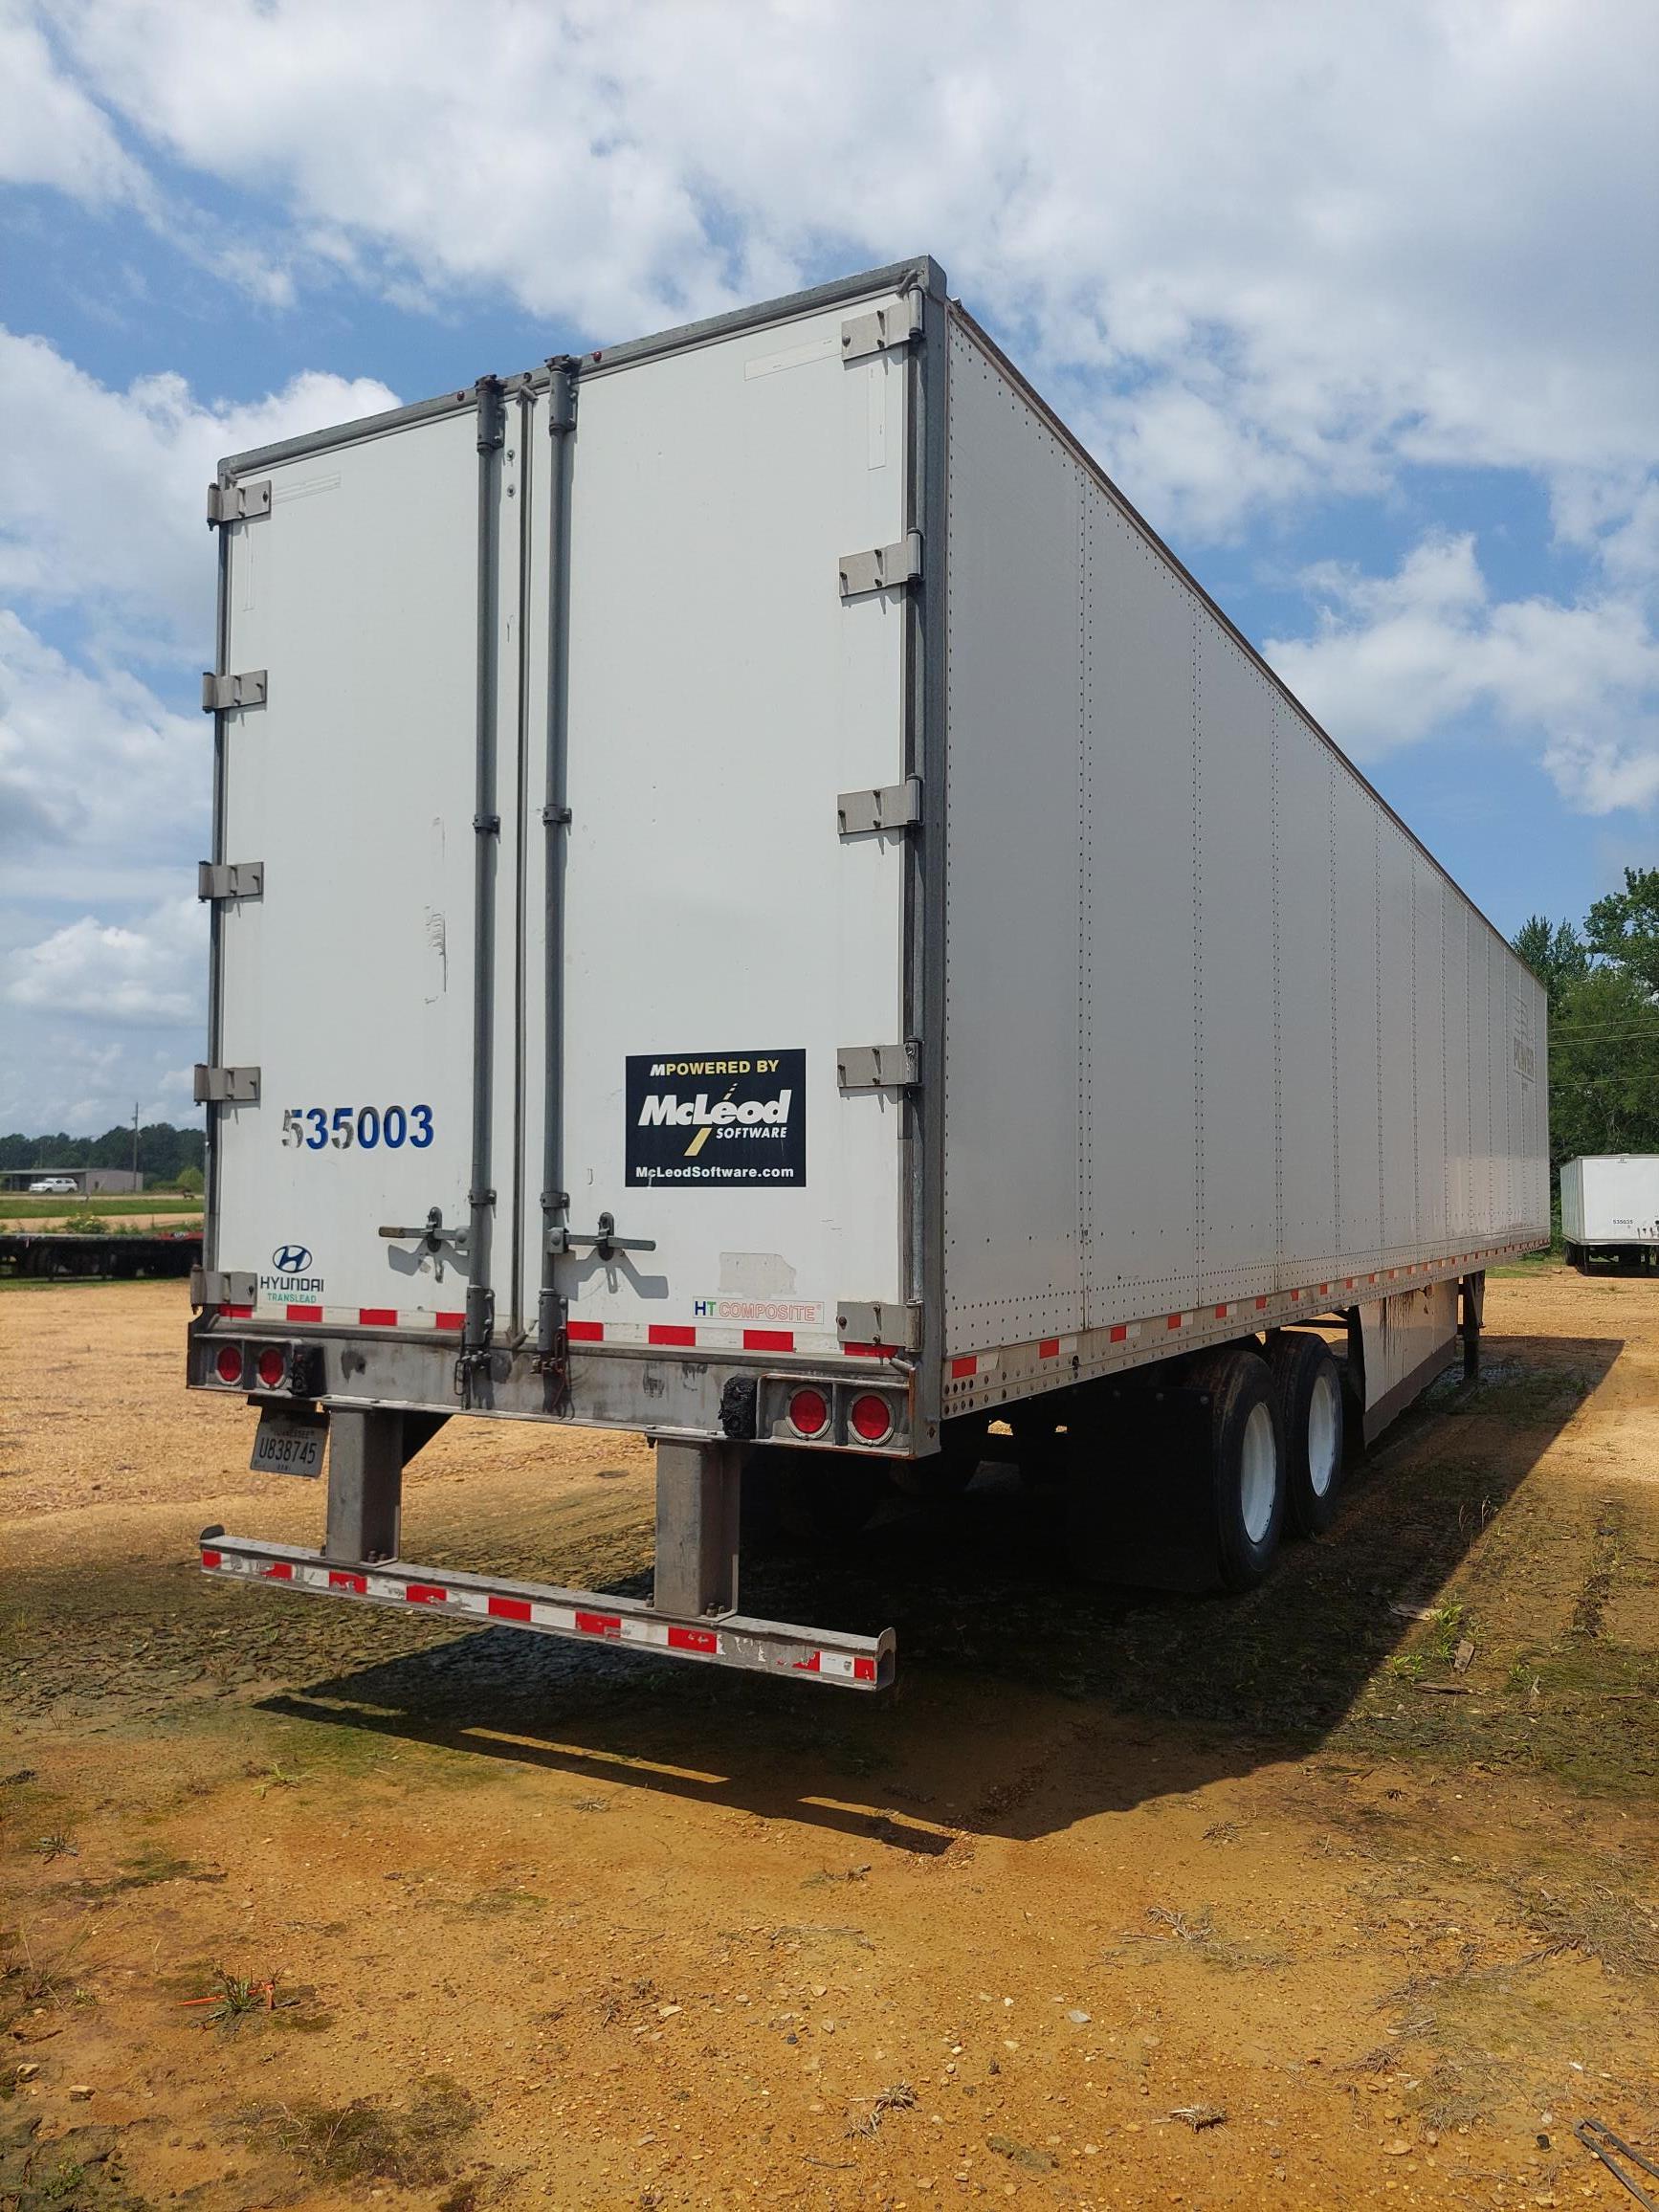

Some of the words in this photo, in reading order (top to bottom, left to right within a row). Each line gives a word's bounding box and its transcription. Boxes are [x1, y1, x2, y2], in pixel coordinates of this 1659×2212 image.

[650, 1060, 751, 1076] MPOWERED
[757, 1059, 780, 1073] BY
[281, 1104, 434, 1149] 535003
[716, 1127, 787, 1139] SOFTWARE
[635, 1166, 794, 1178] McLeodSoftware.com
[260, 1276, 324, 1292] HYUNDAI
[268, 1293, 317, 1303] TRANSLEAD
[695, 1301, 716, 1316] HT
[259, 1437, 317, 1464] U838745
